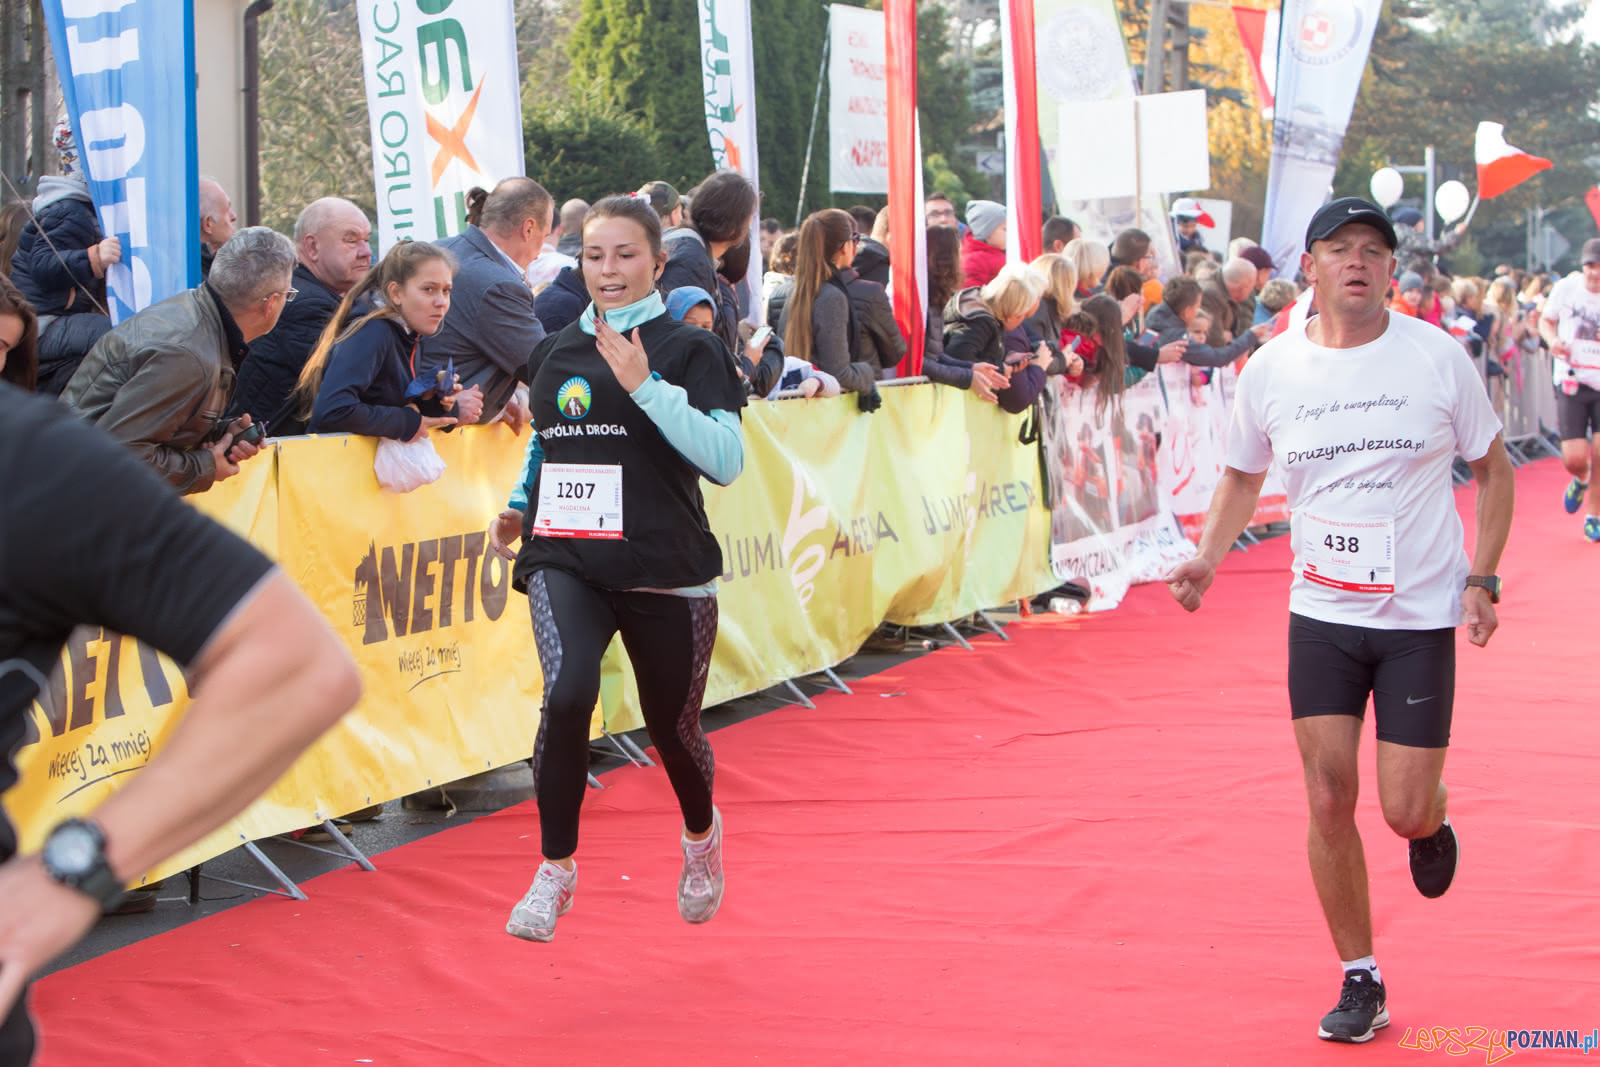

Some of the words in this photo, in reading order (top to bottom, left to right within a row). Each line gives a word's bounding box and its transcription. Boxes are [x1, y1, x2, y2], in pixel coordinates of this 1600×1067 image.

[1303, 403, 1328, 422] pasji
[1330, 400, 1340, 412] do
[586, 423, 628, 436] DROGA
[1287, 437, 1425, 464] DruzynaJezusa.pl
[557, 482, 596, 499] 1207
[1324, 534, 1360, 553] 438
[380, 531, 509, 638] NETTO
[110, 730, 152, 762] mniej
